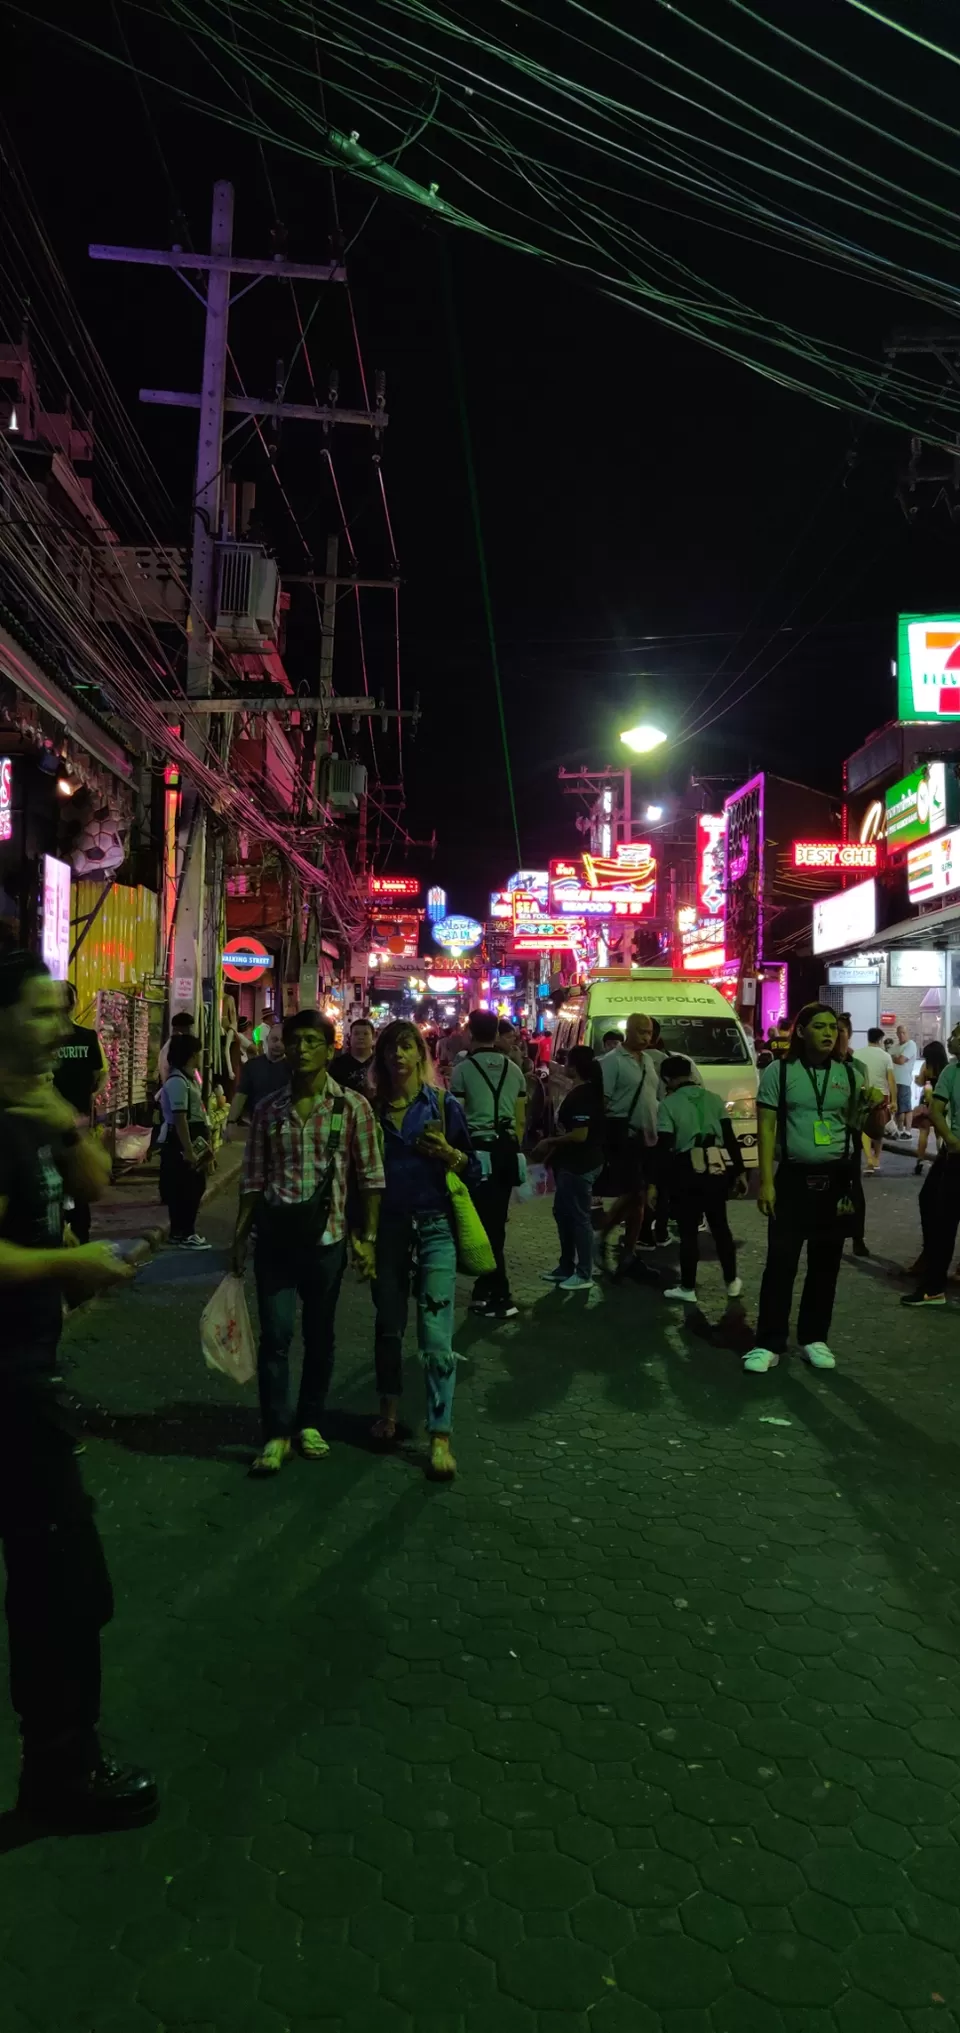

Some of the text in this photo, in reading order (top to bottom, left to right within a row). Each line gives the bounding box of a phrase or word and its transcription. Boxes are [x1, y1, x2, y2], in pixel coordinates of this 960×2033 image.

[797, 848, 872, 862] BEST CHI
[248, 956, 270, 965] STREET
[605, 995, 717, 1005] TOURIST POLICE
[659, 1018, 704, 1027] LICE
